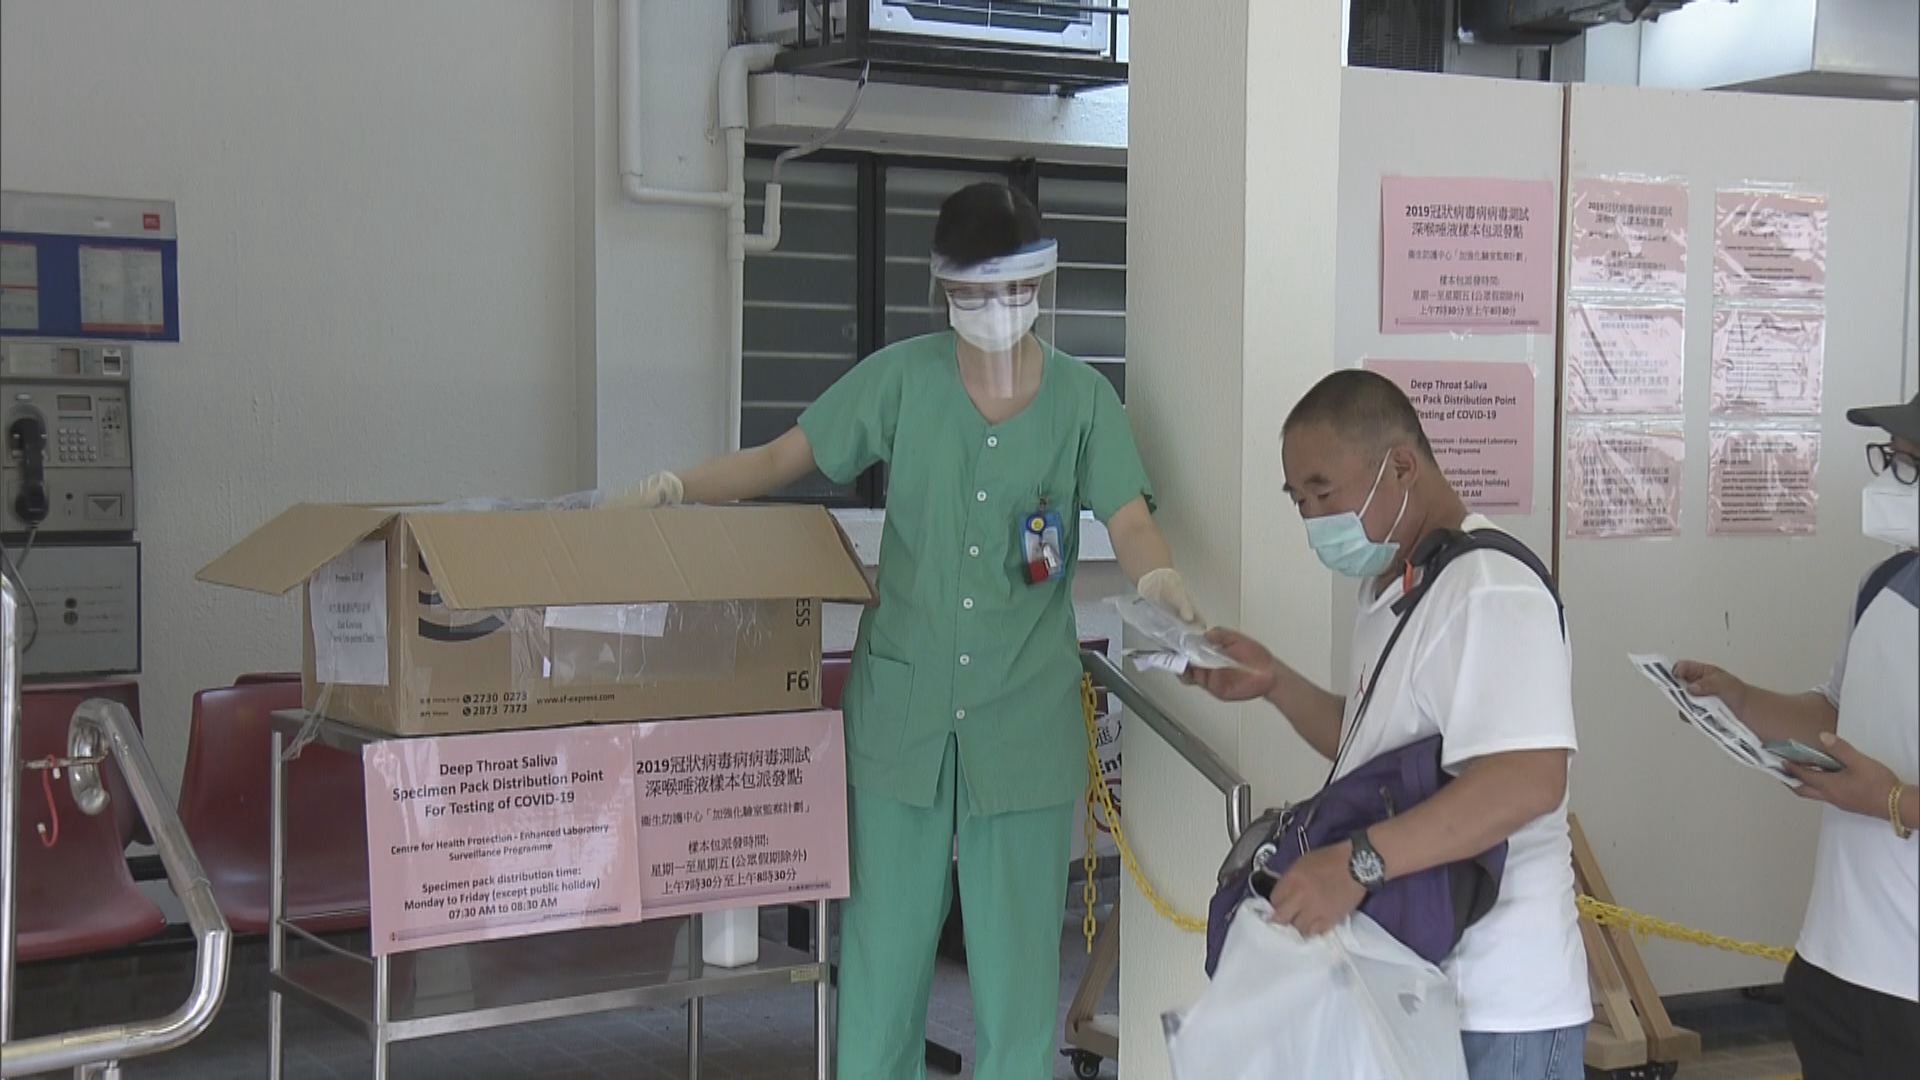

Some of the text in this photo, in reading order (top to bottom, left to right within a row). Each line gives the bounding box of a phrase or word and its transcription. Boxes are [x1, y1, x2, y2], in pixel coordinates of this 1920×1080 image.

[1410, 379, 1487, 391] Deep Throat Saliva
[1423, 395, 1441, 404] Pack
[1444, 395, 1493, 405] Distribution
[1495, 396, 1516, 405] Point
[1446, 410, 1455, 419] of
[1457, 410, 1496, 419] COVID-19
[787, 670, 809, 692] F6
[472, 693, 498, 704] 2730
[503, 691, 528, 702] 0273
[472, 703, 528, 716] 2873 7373
[440, 754, 558, 777] Deep Throat Saliva
[636, 746, 811, 775] 2019冠狀病毒病病毒測試
[392, 769, 604, 802] Specimen Pack Distribution Point
[645, 767, 803, 798] 深喉唾液樣本包派發點
[425, 790, 575, 818] For Testing of COVID-19
[391, 844, 419, 855] Centre
[421, 841, 434, 852] for
[437, 838, 465, 850] Health
[467, 833, 513, 847] Protection
[520, 827, 561, 841] Enhanced
[563, 823, 609, 837] Laboratory
[448, 843, 553, 861] Surveillance Programme
[422, 866, 582, 895] Specimen pack distribution time:
[404, 878, 600, 912] Monday to Friday (except public holiday)
[448, 906, 476, 920] 07:30
[478, 904, 496, 916] AM
[498, 903, 509, 914] to
[511, 899, 538, 912] 08:30
[540, 897, 558, 908] AM
